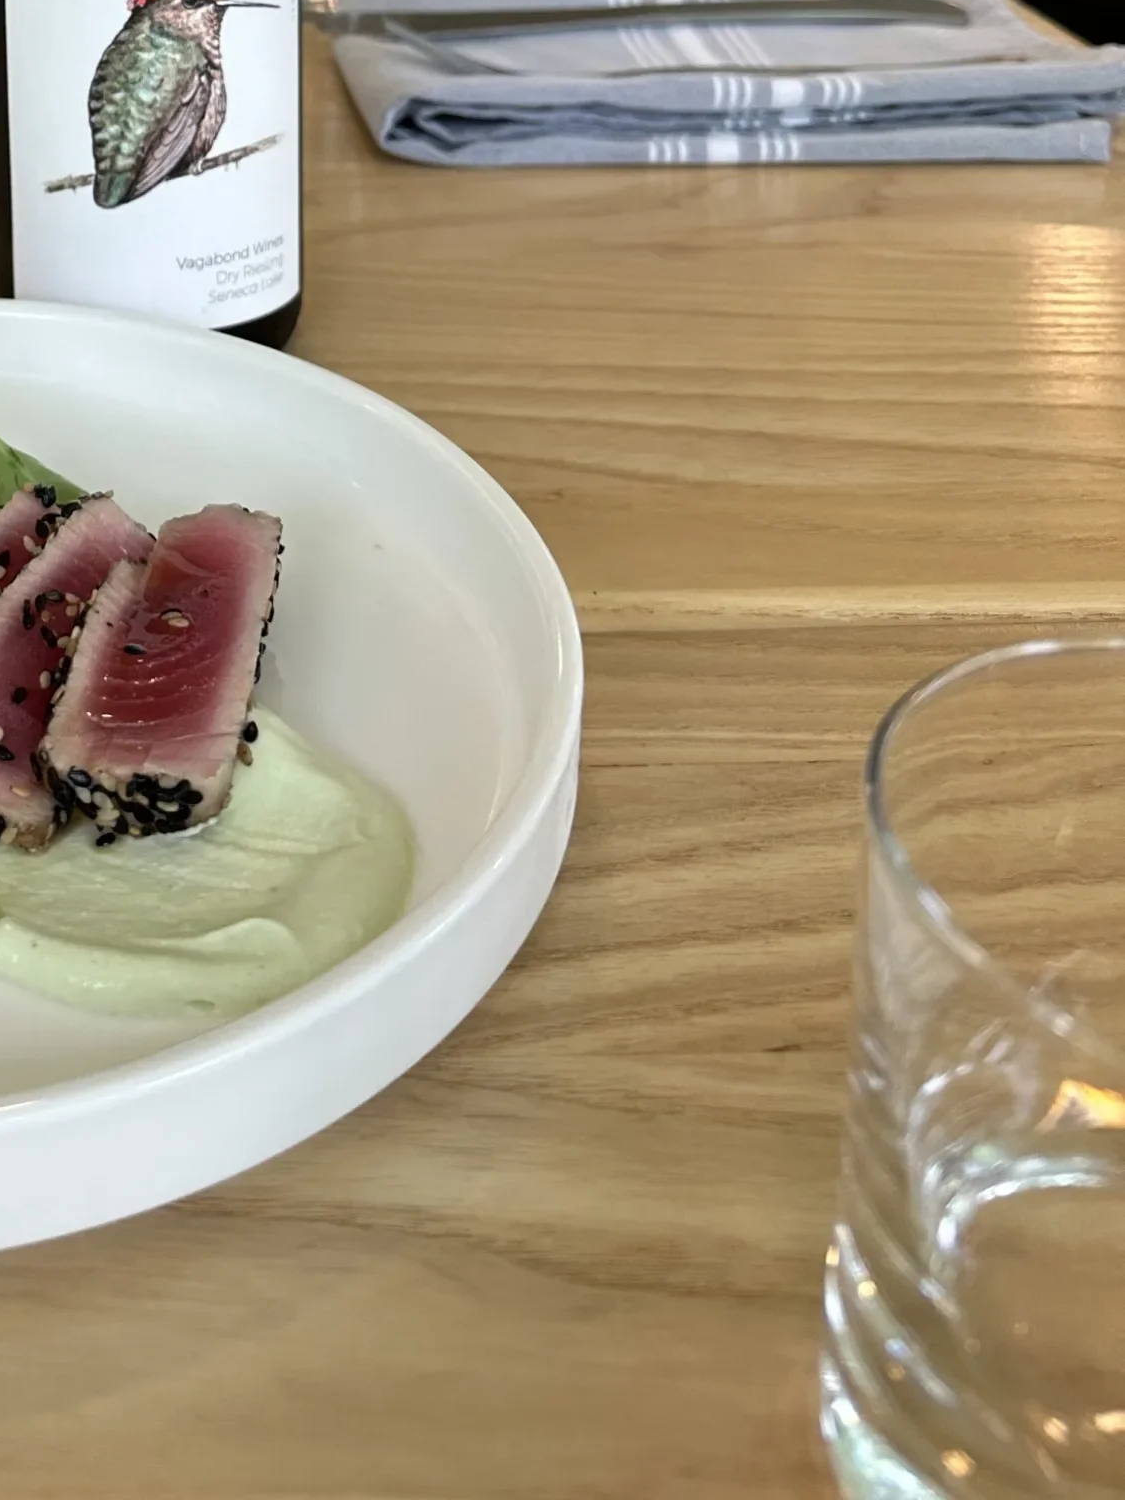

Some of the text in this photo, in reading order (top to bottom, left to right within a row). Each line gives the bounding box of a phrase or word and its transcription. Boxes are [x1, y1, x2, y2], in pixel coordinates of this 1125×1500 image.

[176, 245, 249, 270] Vagabond
[216, 269, 239, 285] Dry
[208, 282, 258, 304] Seneca
